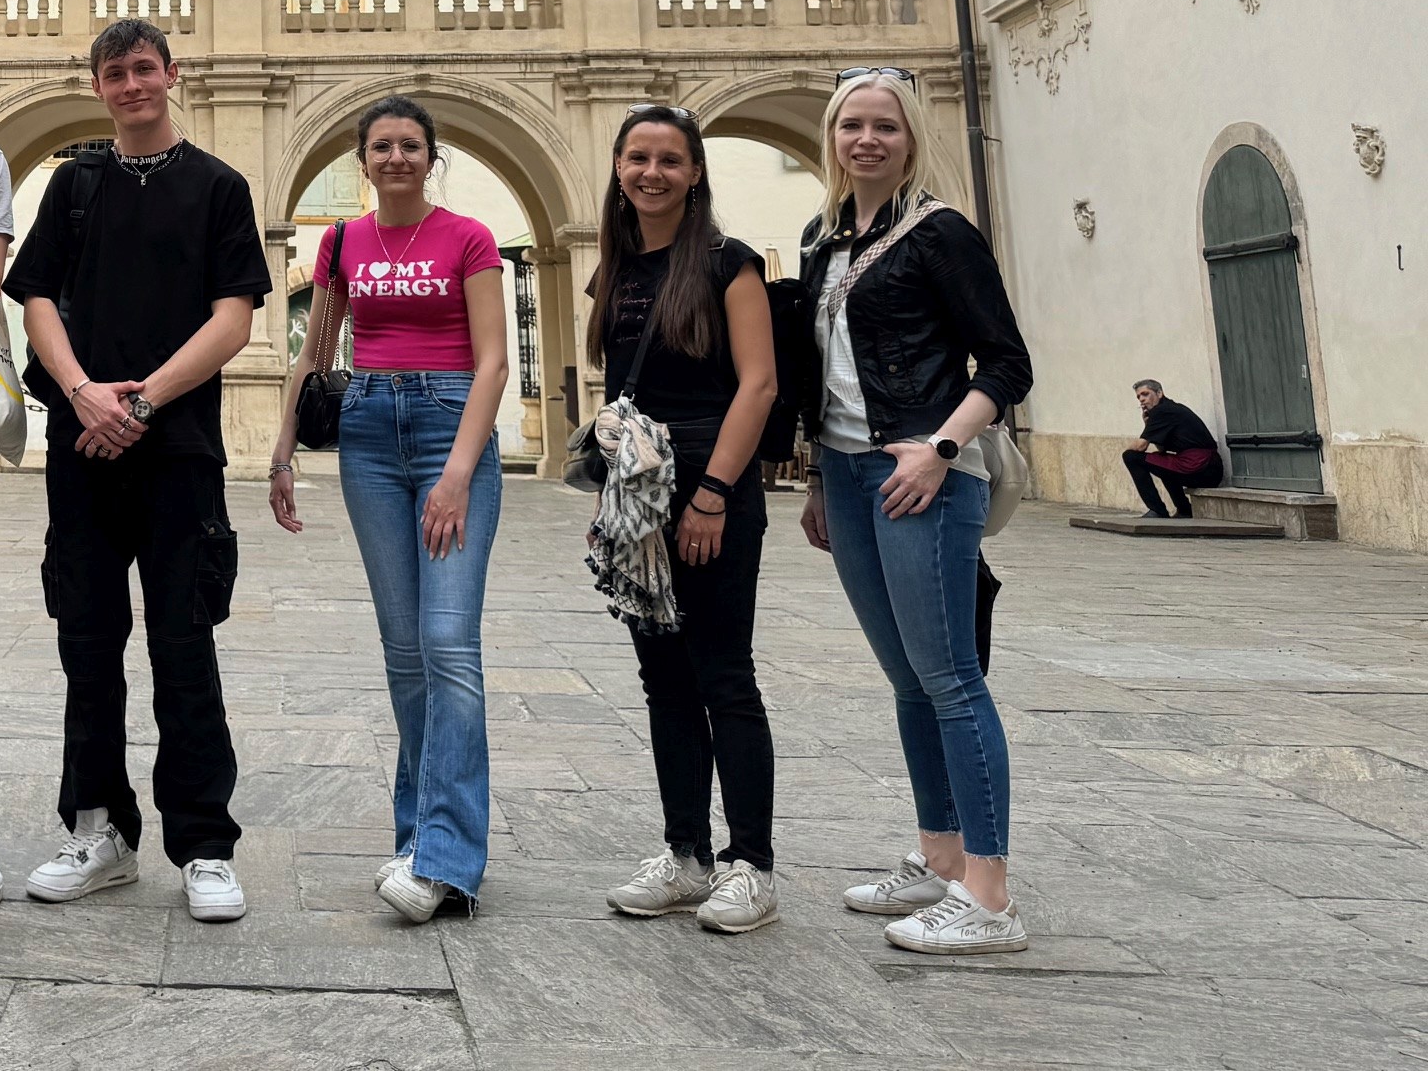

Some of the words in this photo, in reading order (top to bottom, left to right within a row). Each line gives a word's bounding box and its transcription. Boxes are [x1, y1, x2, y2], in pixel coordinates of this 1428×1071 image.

[139, 152, 168, 166] Angels
[355, 263, 364, 279] I
[395, 260, 435, 277] MY
[348, 278, 450, 298] ENERGY
